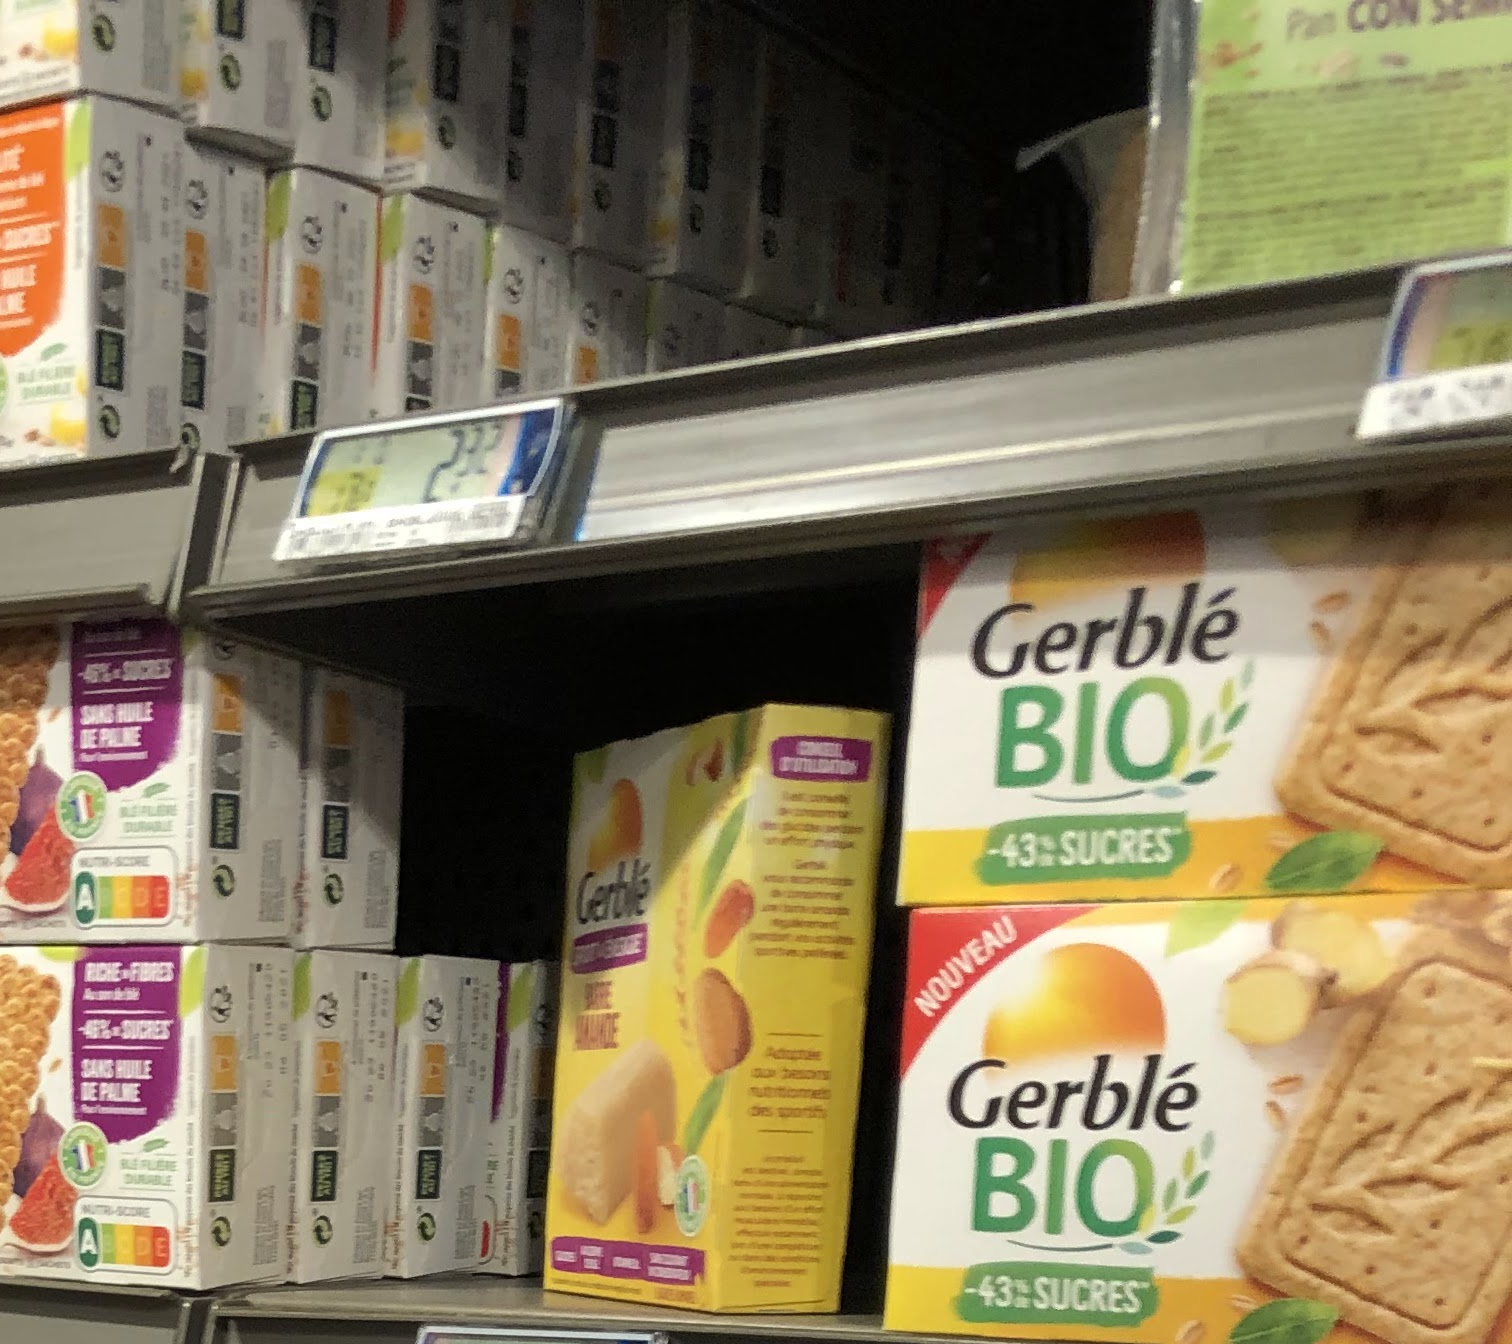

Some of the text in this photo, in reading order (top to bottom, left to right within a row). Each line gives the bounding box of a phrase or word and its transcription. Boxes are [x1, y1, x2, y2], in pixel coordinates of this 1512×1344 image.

[971, 581, 1240, 680] Gerblé
[995, 676, 1192, 789] BIO
[914, 916, 1019, 1017] NOUVEAU
[948, 1053, 1201, 1132] Gerblé
[971, 1137, 1155, 1237] BIO
